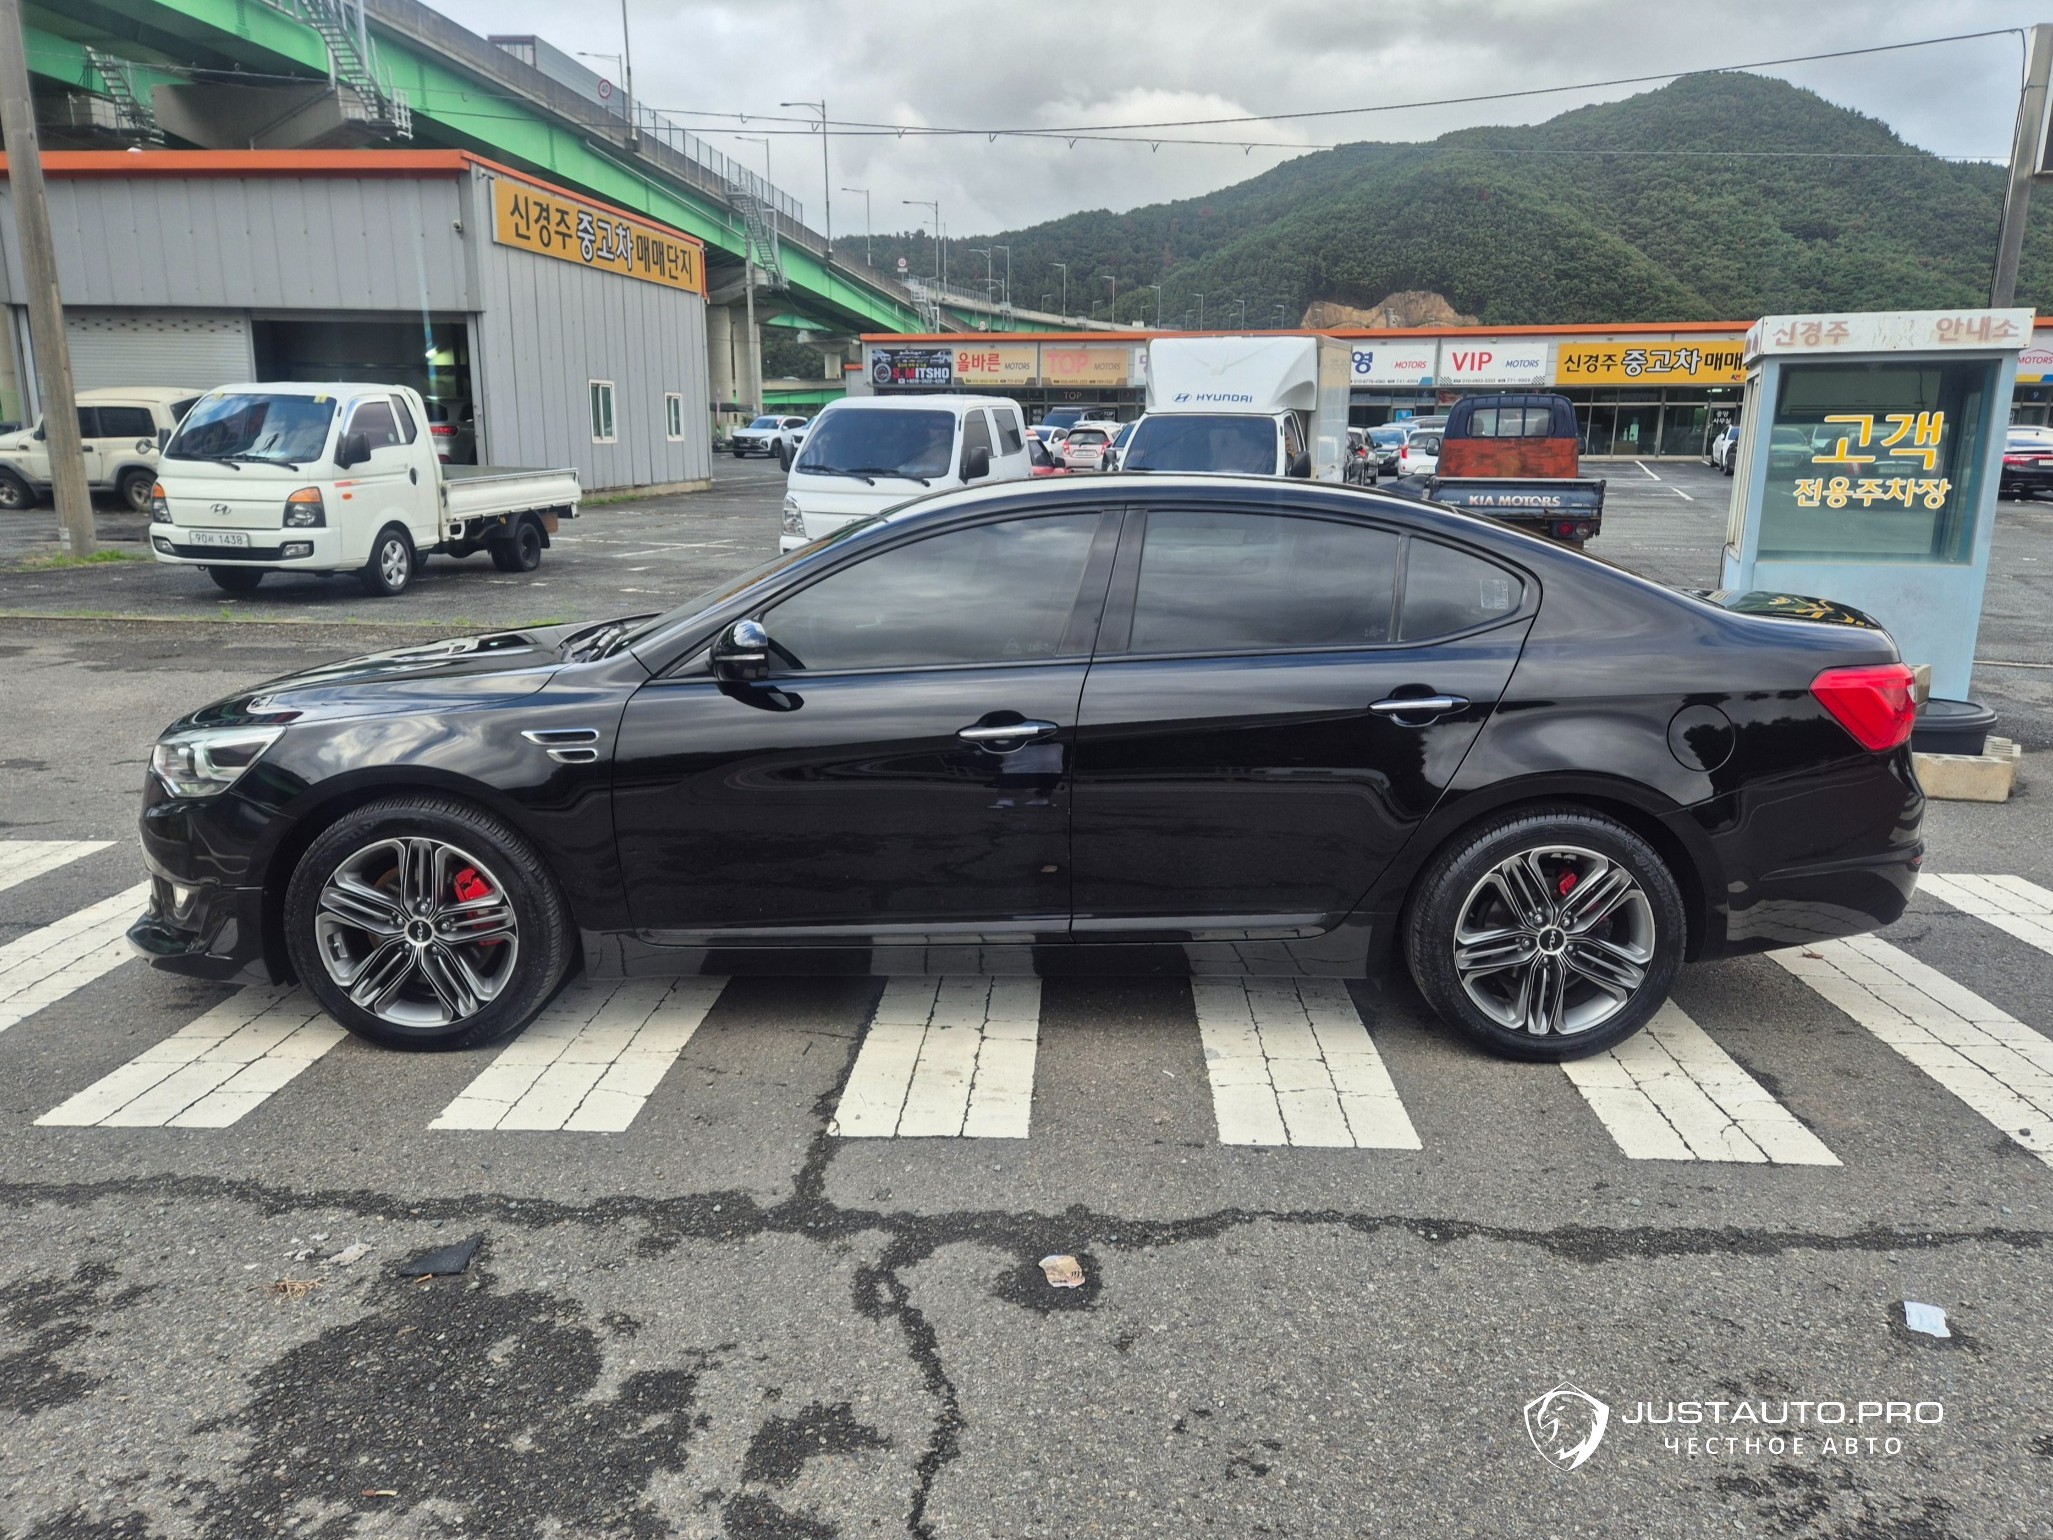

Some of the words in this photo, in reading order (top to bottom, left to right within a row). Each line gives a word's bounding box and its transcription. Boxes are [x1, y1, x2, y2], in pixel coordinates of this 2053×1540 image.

[510, 194, 573, 249] 신경주
[576, 209, 633, 271] 중고차
[636, 234, 692, 284] 매매단지
[1774, 321, 1850, 347] 신경주
[1936, 317, 2019, 342] 안내소
[956, 352, 1001, 372] 올바른
[1004, 362, 1030, 370] MOTORS
[1049, 352, 1090, 374] TOP
[1093, 363, 1121, 371] MOTORS
[1352, 351, 1373, 374] 영
[1394, 361, 1427, 369] MOTORS
[1452, 352, 1493, 371] VIP
[1505, 360, 1540, 368] MOTORS
[1564, 354, 1618, 373] 신경주
[1621, 348, 1702, 377] 중고차
[1704, 352, 1749, 371] 매매
[905, 367, 949, 379] MITSHO
[1064, 392, 1082, 400] TOP
[1196, 393, 1253, 403] HYUNDAI
[1811, 411, 1945, 470] 고객
[1469, 495, 1495, 506] KIA
[1498, 495, 1561, 506] MOTORS
[1793, 476, 1952, 509] 전용주차장
[218, 534, 243, 546] 1438
